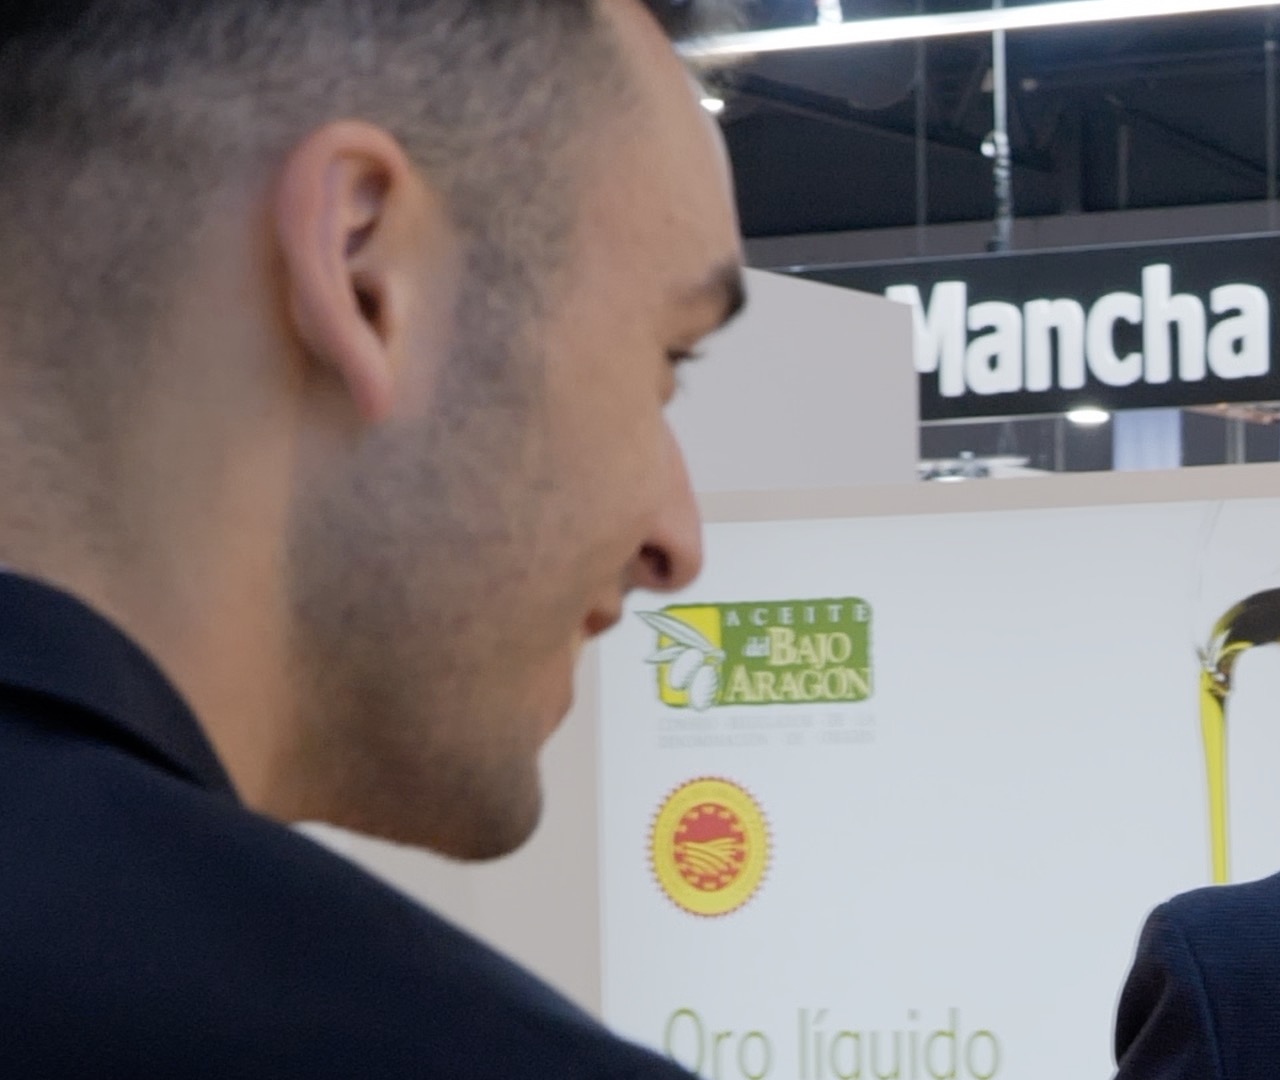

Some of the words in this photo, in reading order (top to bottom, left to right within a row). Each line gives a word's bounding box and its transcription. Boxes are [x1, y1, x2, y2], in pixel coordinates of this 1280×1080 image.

[885, 263, 1270, 397] Mancha
[725, 604, 871, 627] ACEITE
[768, 626, 852, 669] BAJO
